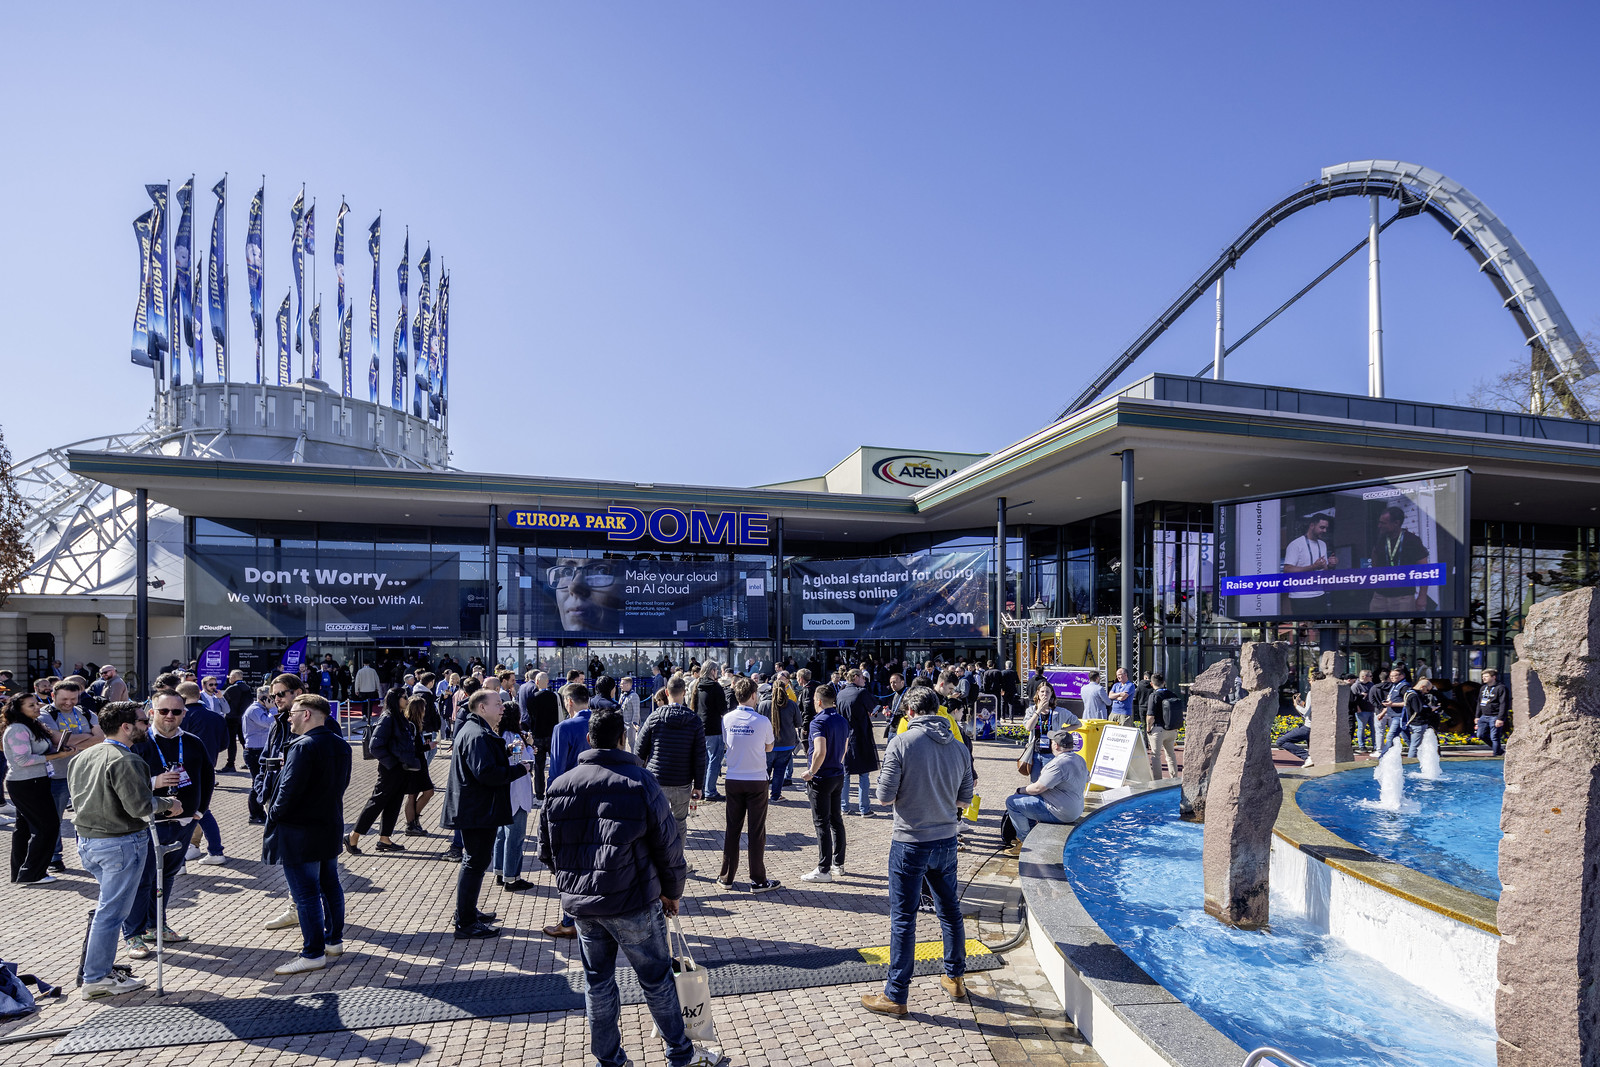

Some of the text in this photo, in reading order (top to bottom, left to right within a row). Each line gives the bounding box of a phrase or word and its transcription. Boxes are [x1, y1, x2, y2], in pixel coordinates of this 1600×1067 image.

[1364, 490, 1399, 499] CLOUDFEST
[516, 512, 627, 530] EUROPA PARK
[607, 505, 769, 547] DOME
[244, 567, 407, 590] Don't Worry...
[625, 570, 717, 583] Make your cloud
[802, 567, 974, 587] A global standard for doing
[1226, 568, 1439, 590] Raise your cloud-industry game fast!
[625, 584, 689, 594] an AI cloud
[748, 583, 762, 591] intel
[802, 587, 898, 600] business online
[227, 592, 423, 607] We Won't Replace You With AI.
[807, 618, 850, 626] YourDot.com
[928, 612, 974, 625] .com
[681, 1002, 704, 1018] 4x7
